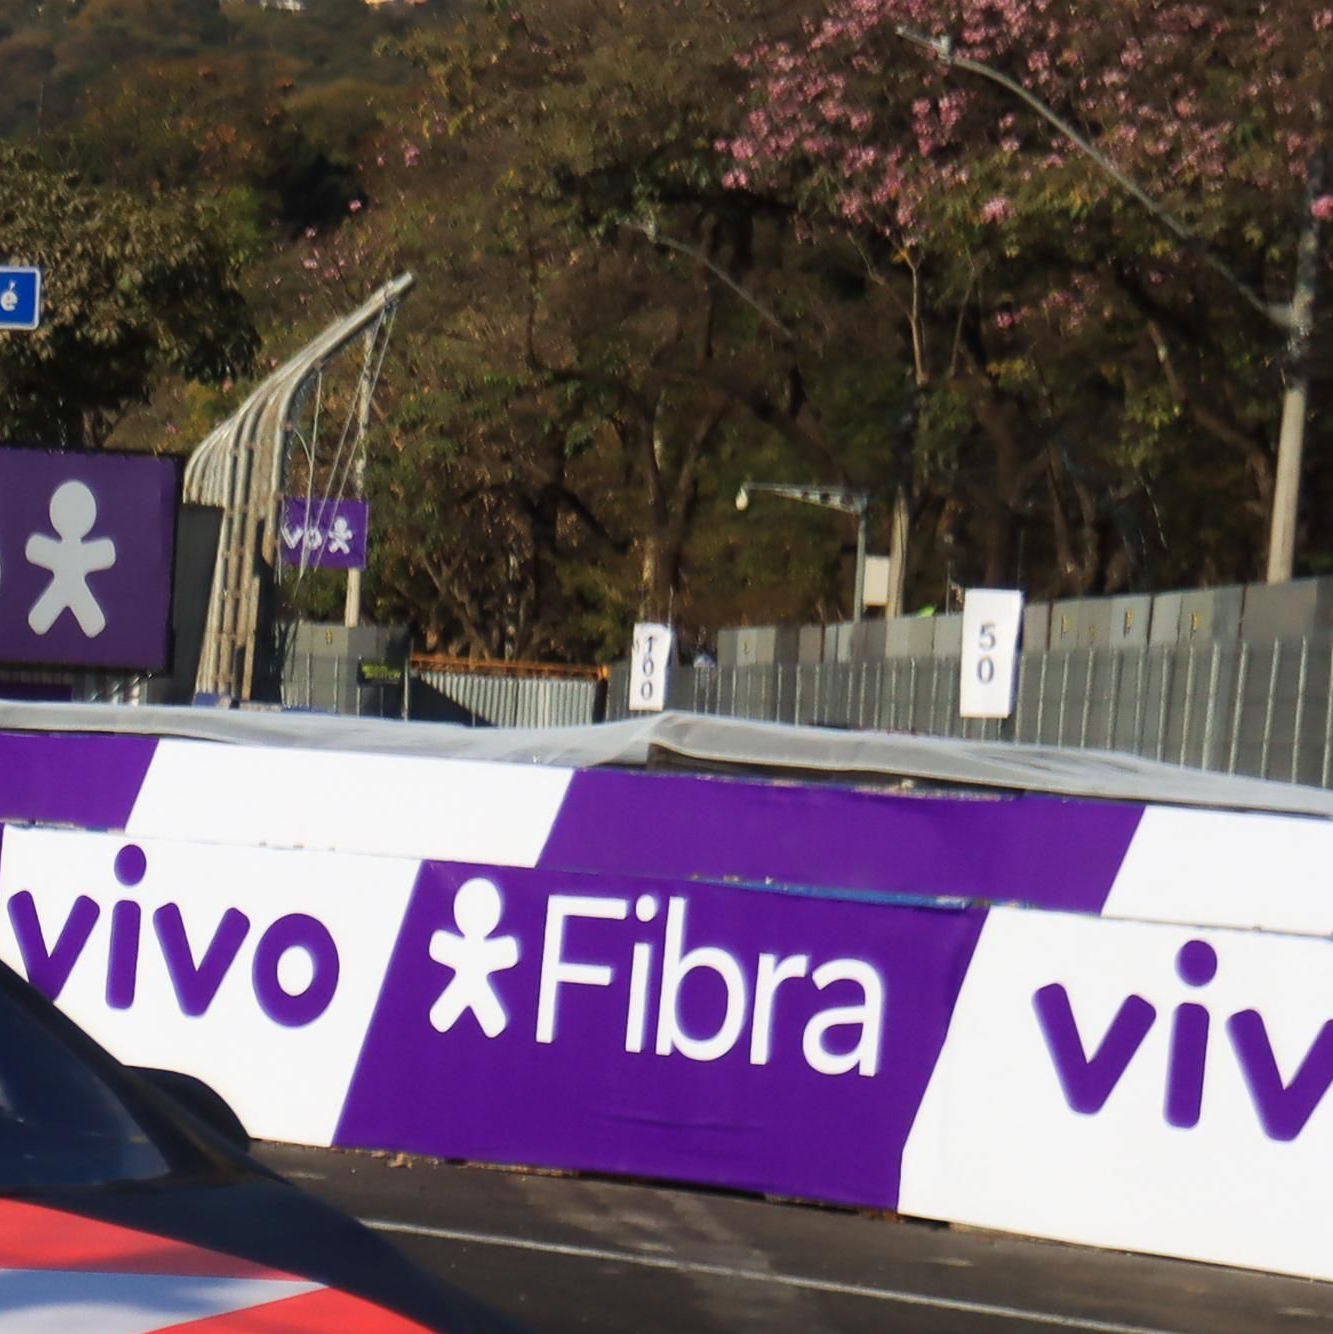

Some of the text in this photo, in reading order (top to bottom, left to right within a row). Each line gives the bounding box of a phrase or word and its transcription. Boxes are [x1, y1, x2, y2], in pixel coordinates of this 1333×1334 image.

[976, 621, 997, 684] 50
[7, 843, 340, 1029] vivo
[535, 894, 885, 1078] Fibra
